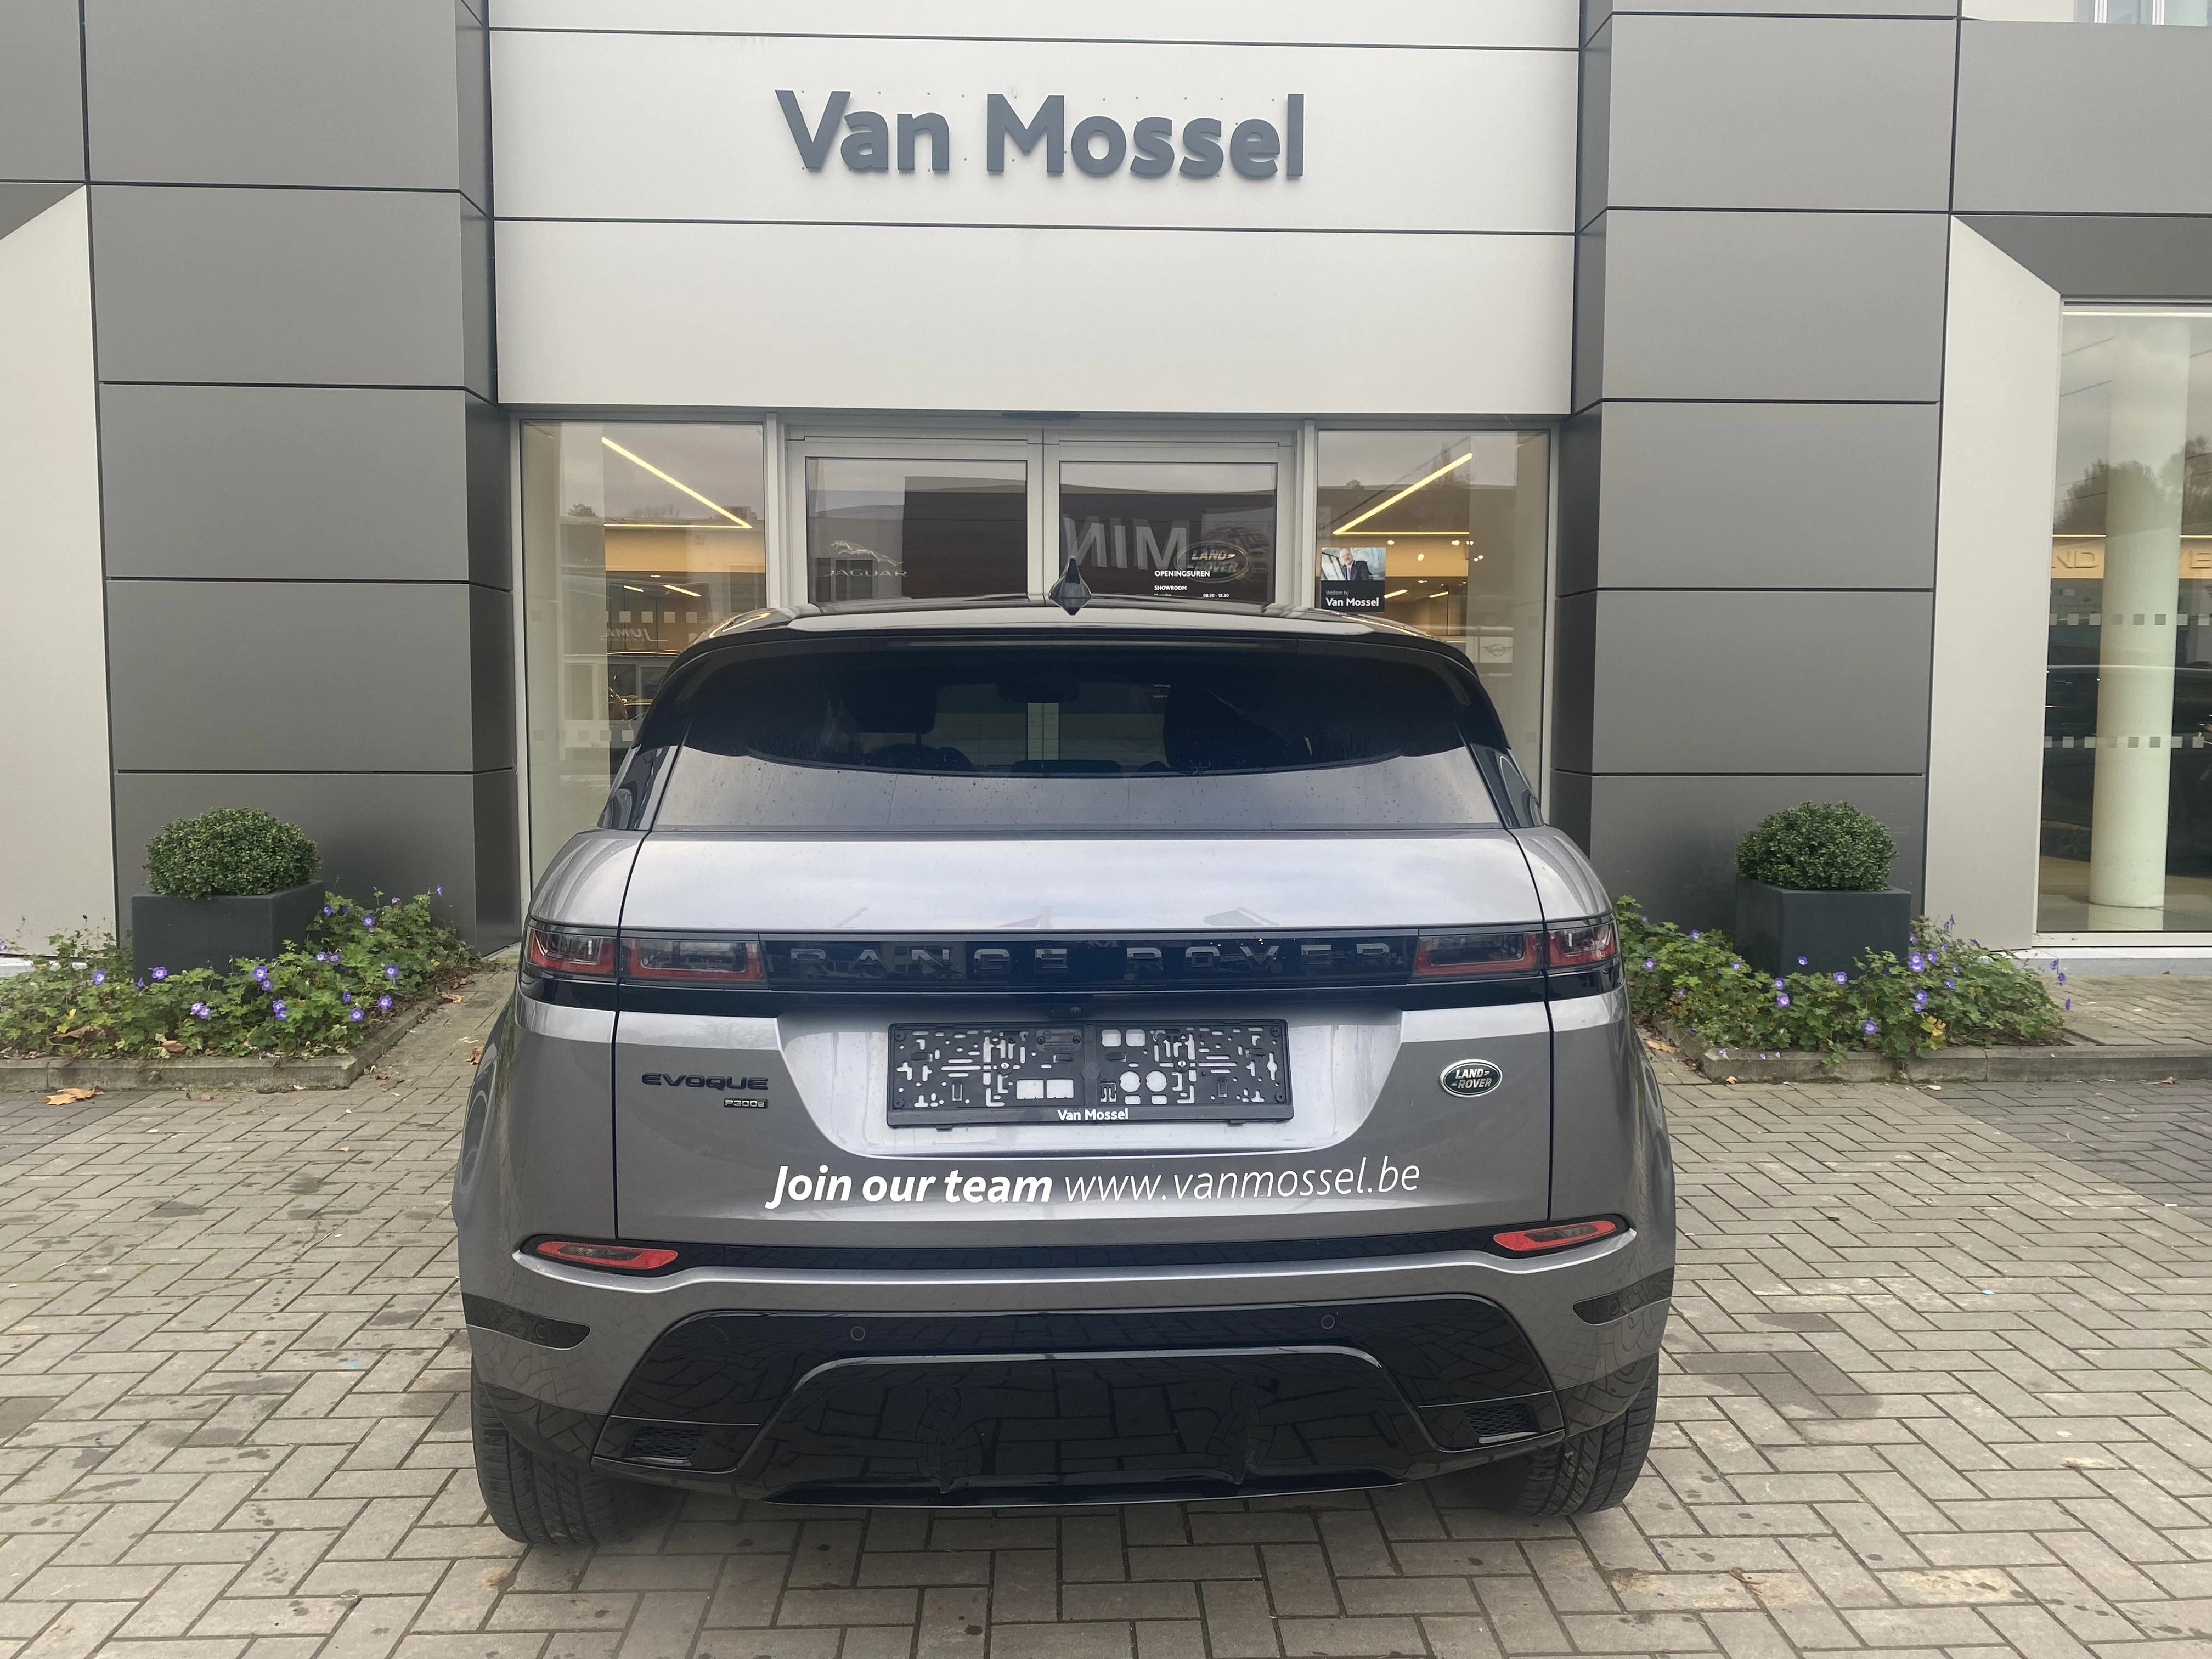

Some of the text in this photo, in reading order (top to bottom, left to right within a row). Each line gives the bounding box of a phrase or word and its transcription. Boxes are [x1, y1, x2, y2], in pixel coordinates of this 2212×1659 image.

[775, 89, 1305, 180] Van Mossel
[1191, 549, 1229, 561] LAND
[1193, 560, 1238, 573] ROVER
[1325, 597, 1379, 606] Van Mossel
[790, 943, 1402, 974] RANGE ROVER
[1455, 1068, 1484, 1079] LAND
[642, 1072, 768, 1091] EVOQUE
[1457, 1078, 1492, 1089] ROVER
[1057, 1108, 1128, 1121] Van Mossel
[764, 1155, 1420, 1209] Join our team www.vanmossel.be
